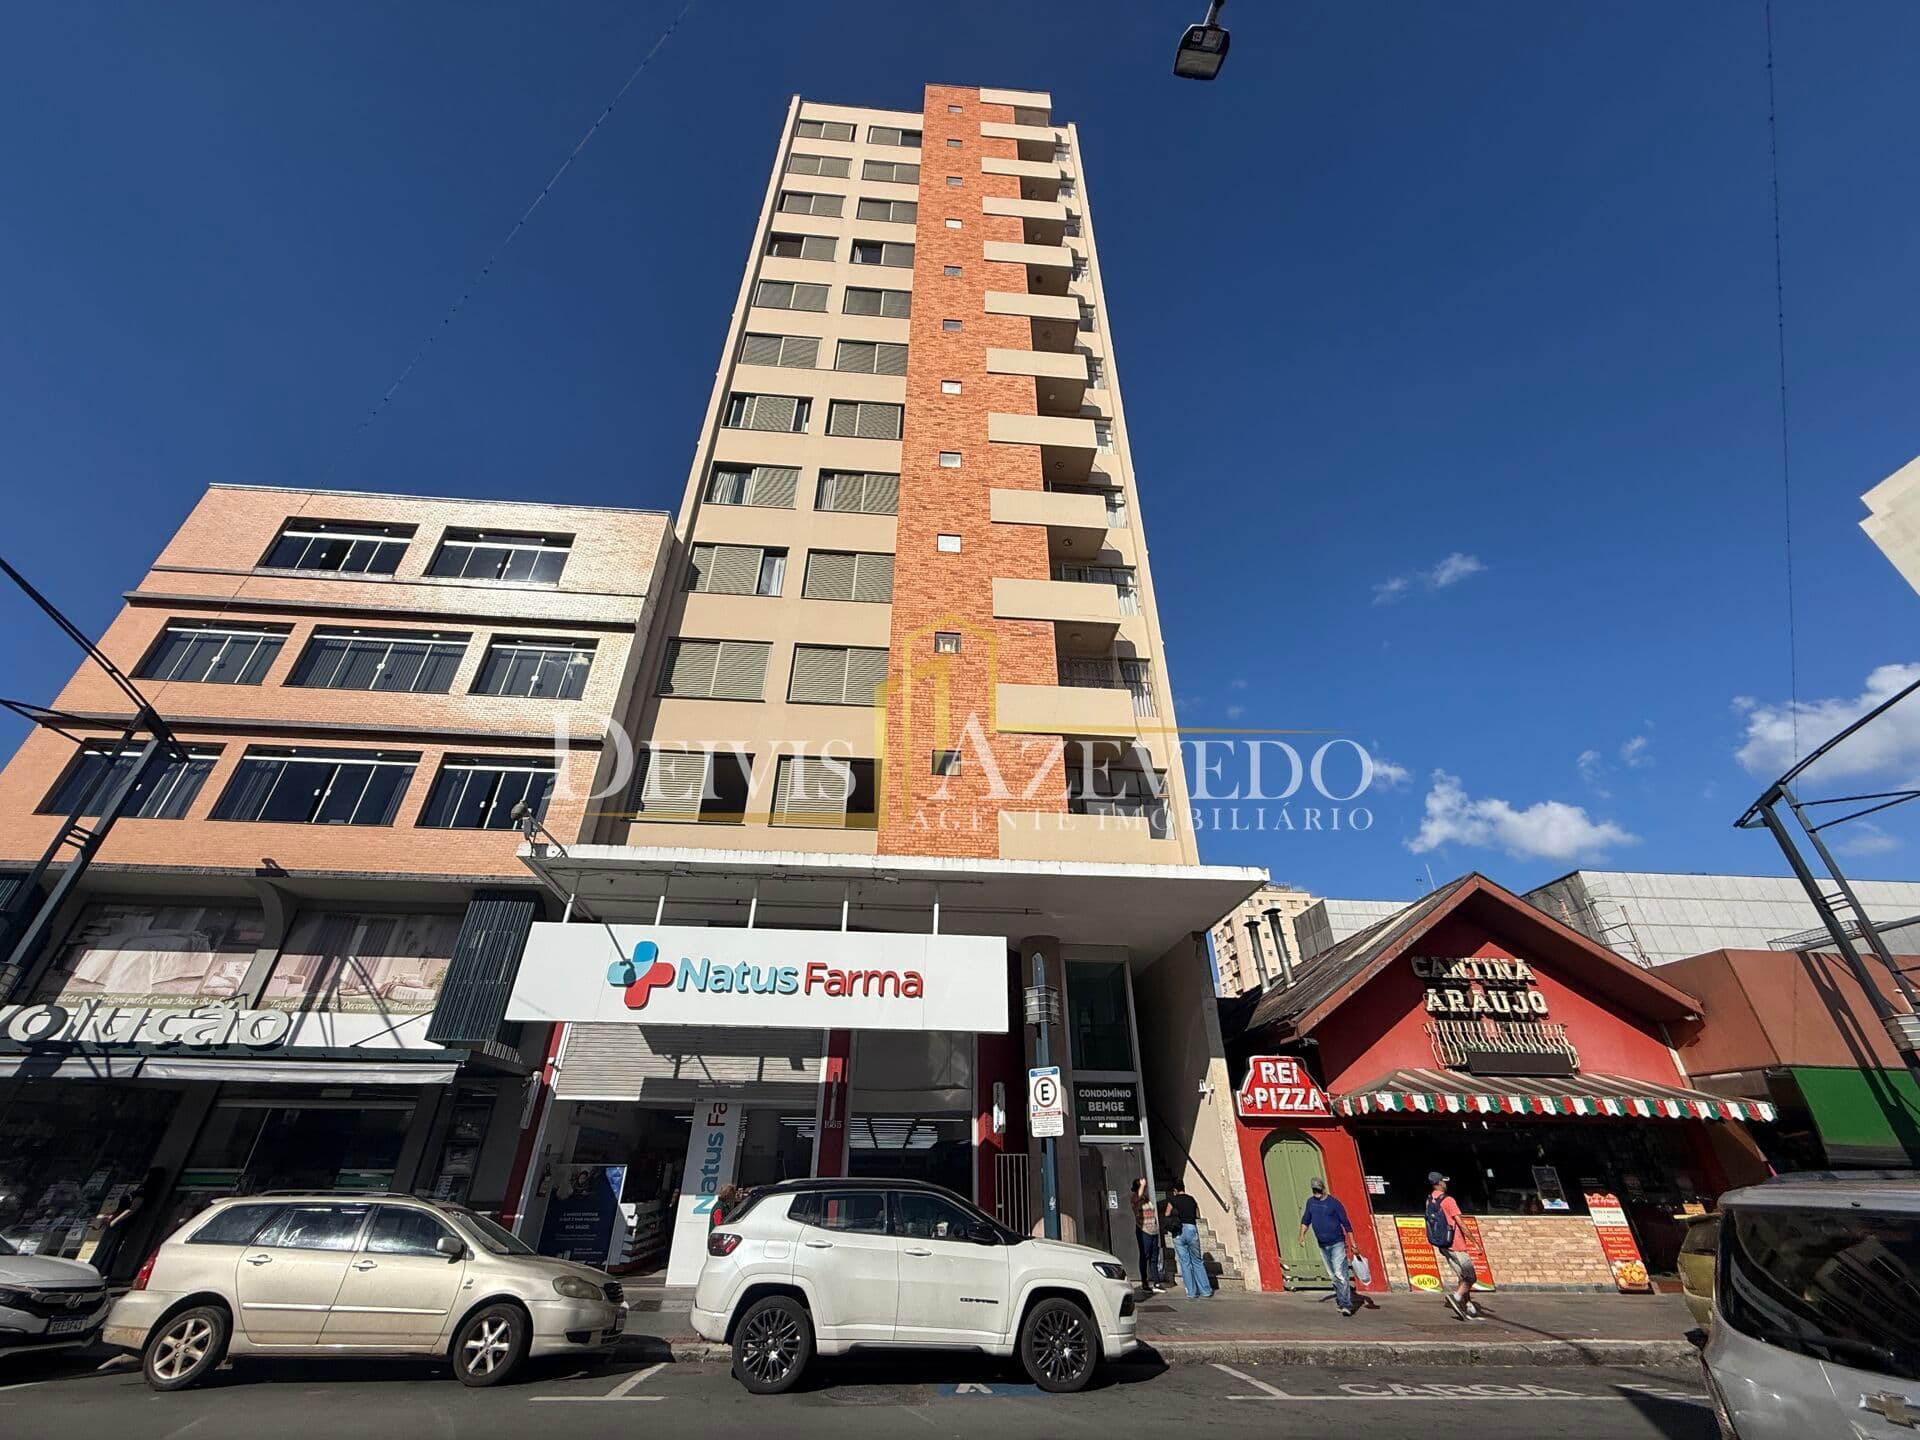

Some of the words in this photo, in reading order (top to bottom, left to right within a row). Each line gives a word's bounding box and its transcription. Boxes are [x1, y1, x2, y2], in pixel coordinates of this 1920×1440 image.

[676, 957, 799, 996] Natus
[804, 962, 924, 998] Farma
[1410, 956, 1537, 981] CANTINA
[1426, 988, 1549, 1014] ARAUJO
[1260, 1062, 1300, 1084] REI
[1041, 1084, 1050, 1101] E
[1079, 1088, 1132, 1098] CONDOMÍNIO
[1254, 1087, 1326, 1110] PIZZA
[1088, 1102, 1125, 1112] BEMGE
[693, 1131, 724, 1214] Natus
[1339, 1384, 1587, 1397] CARGA
